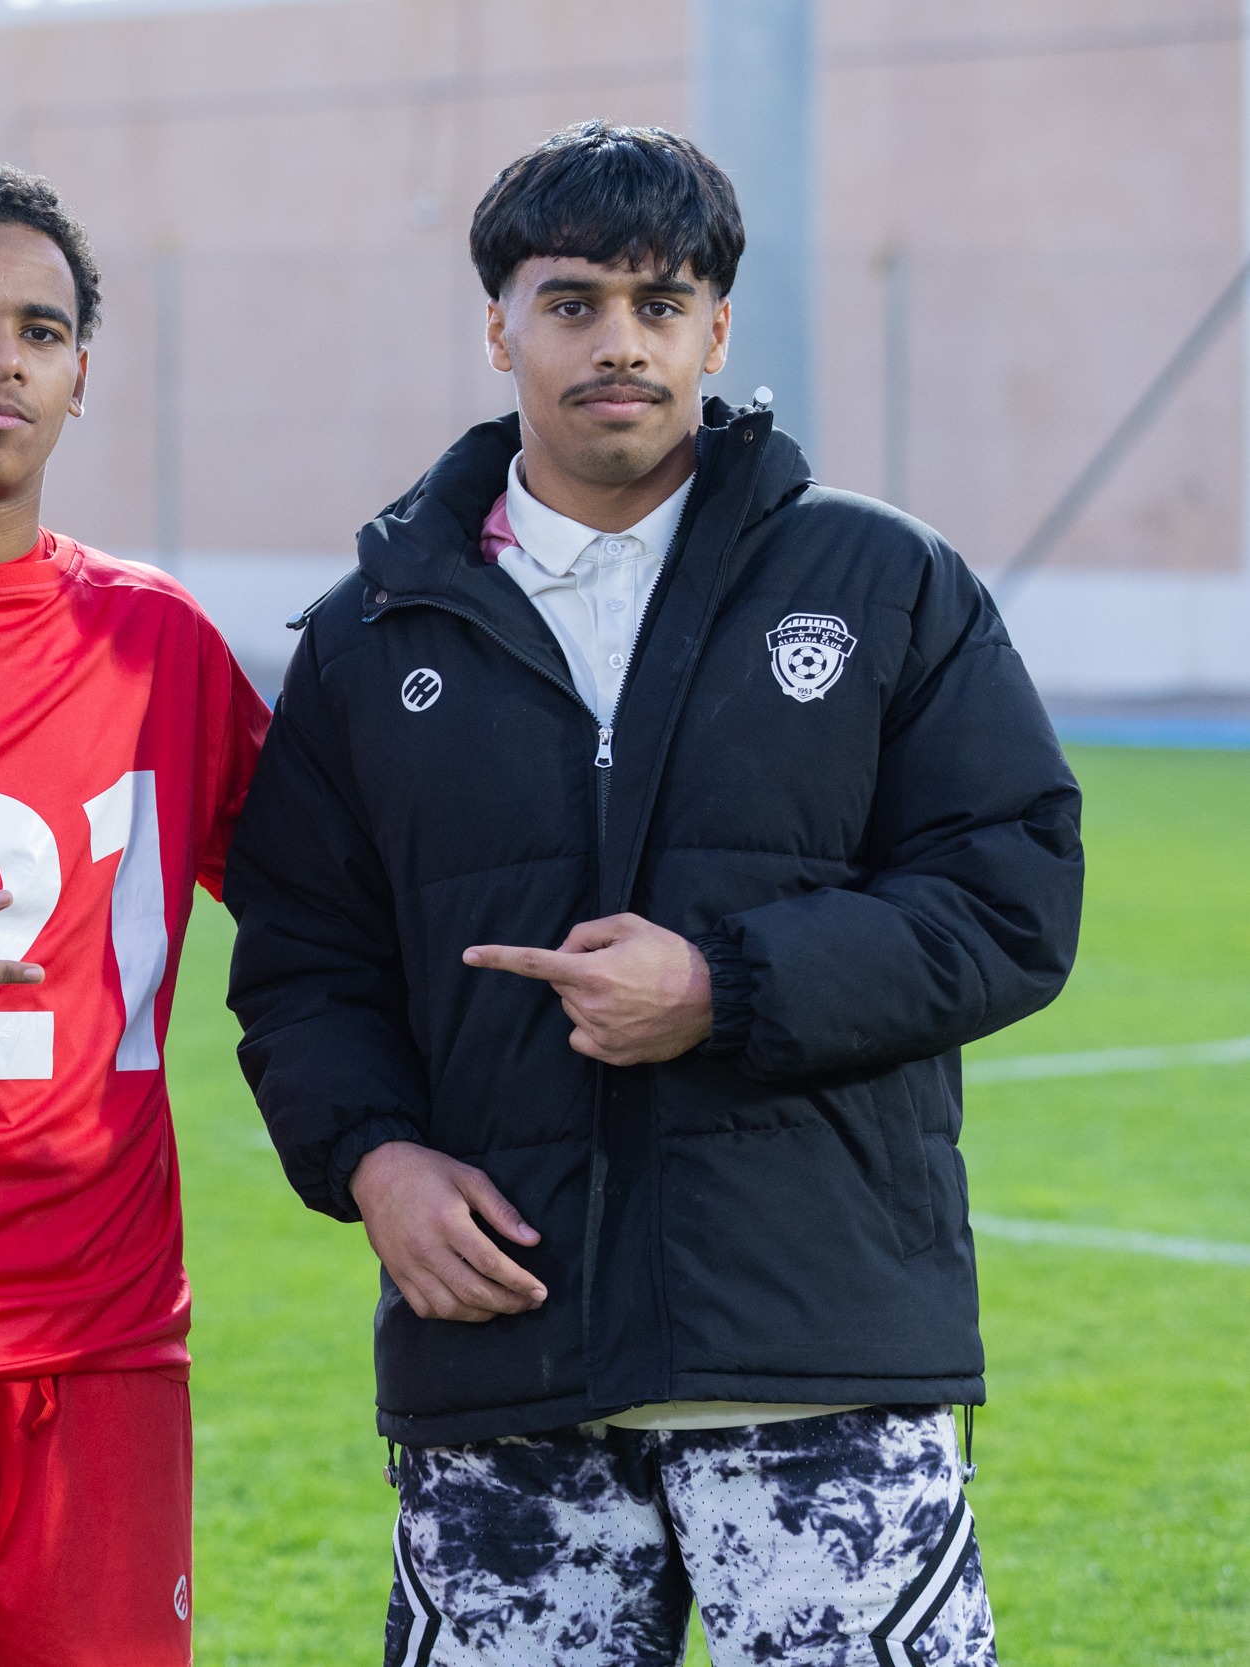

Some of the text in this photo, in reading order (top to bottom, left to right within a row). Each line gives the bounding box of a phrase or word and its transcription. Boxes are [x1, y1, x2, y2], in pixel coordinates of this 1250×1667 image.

[778, 637, 842, 650] ALFAYHA CLUB
[797, 687, 813, 695] 1953
